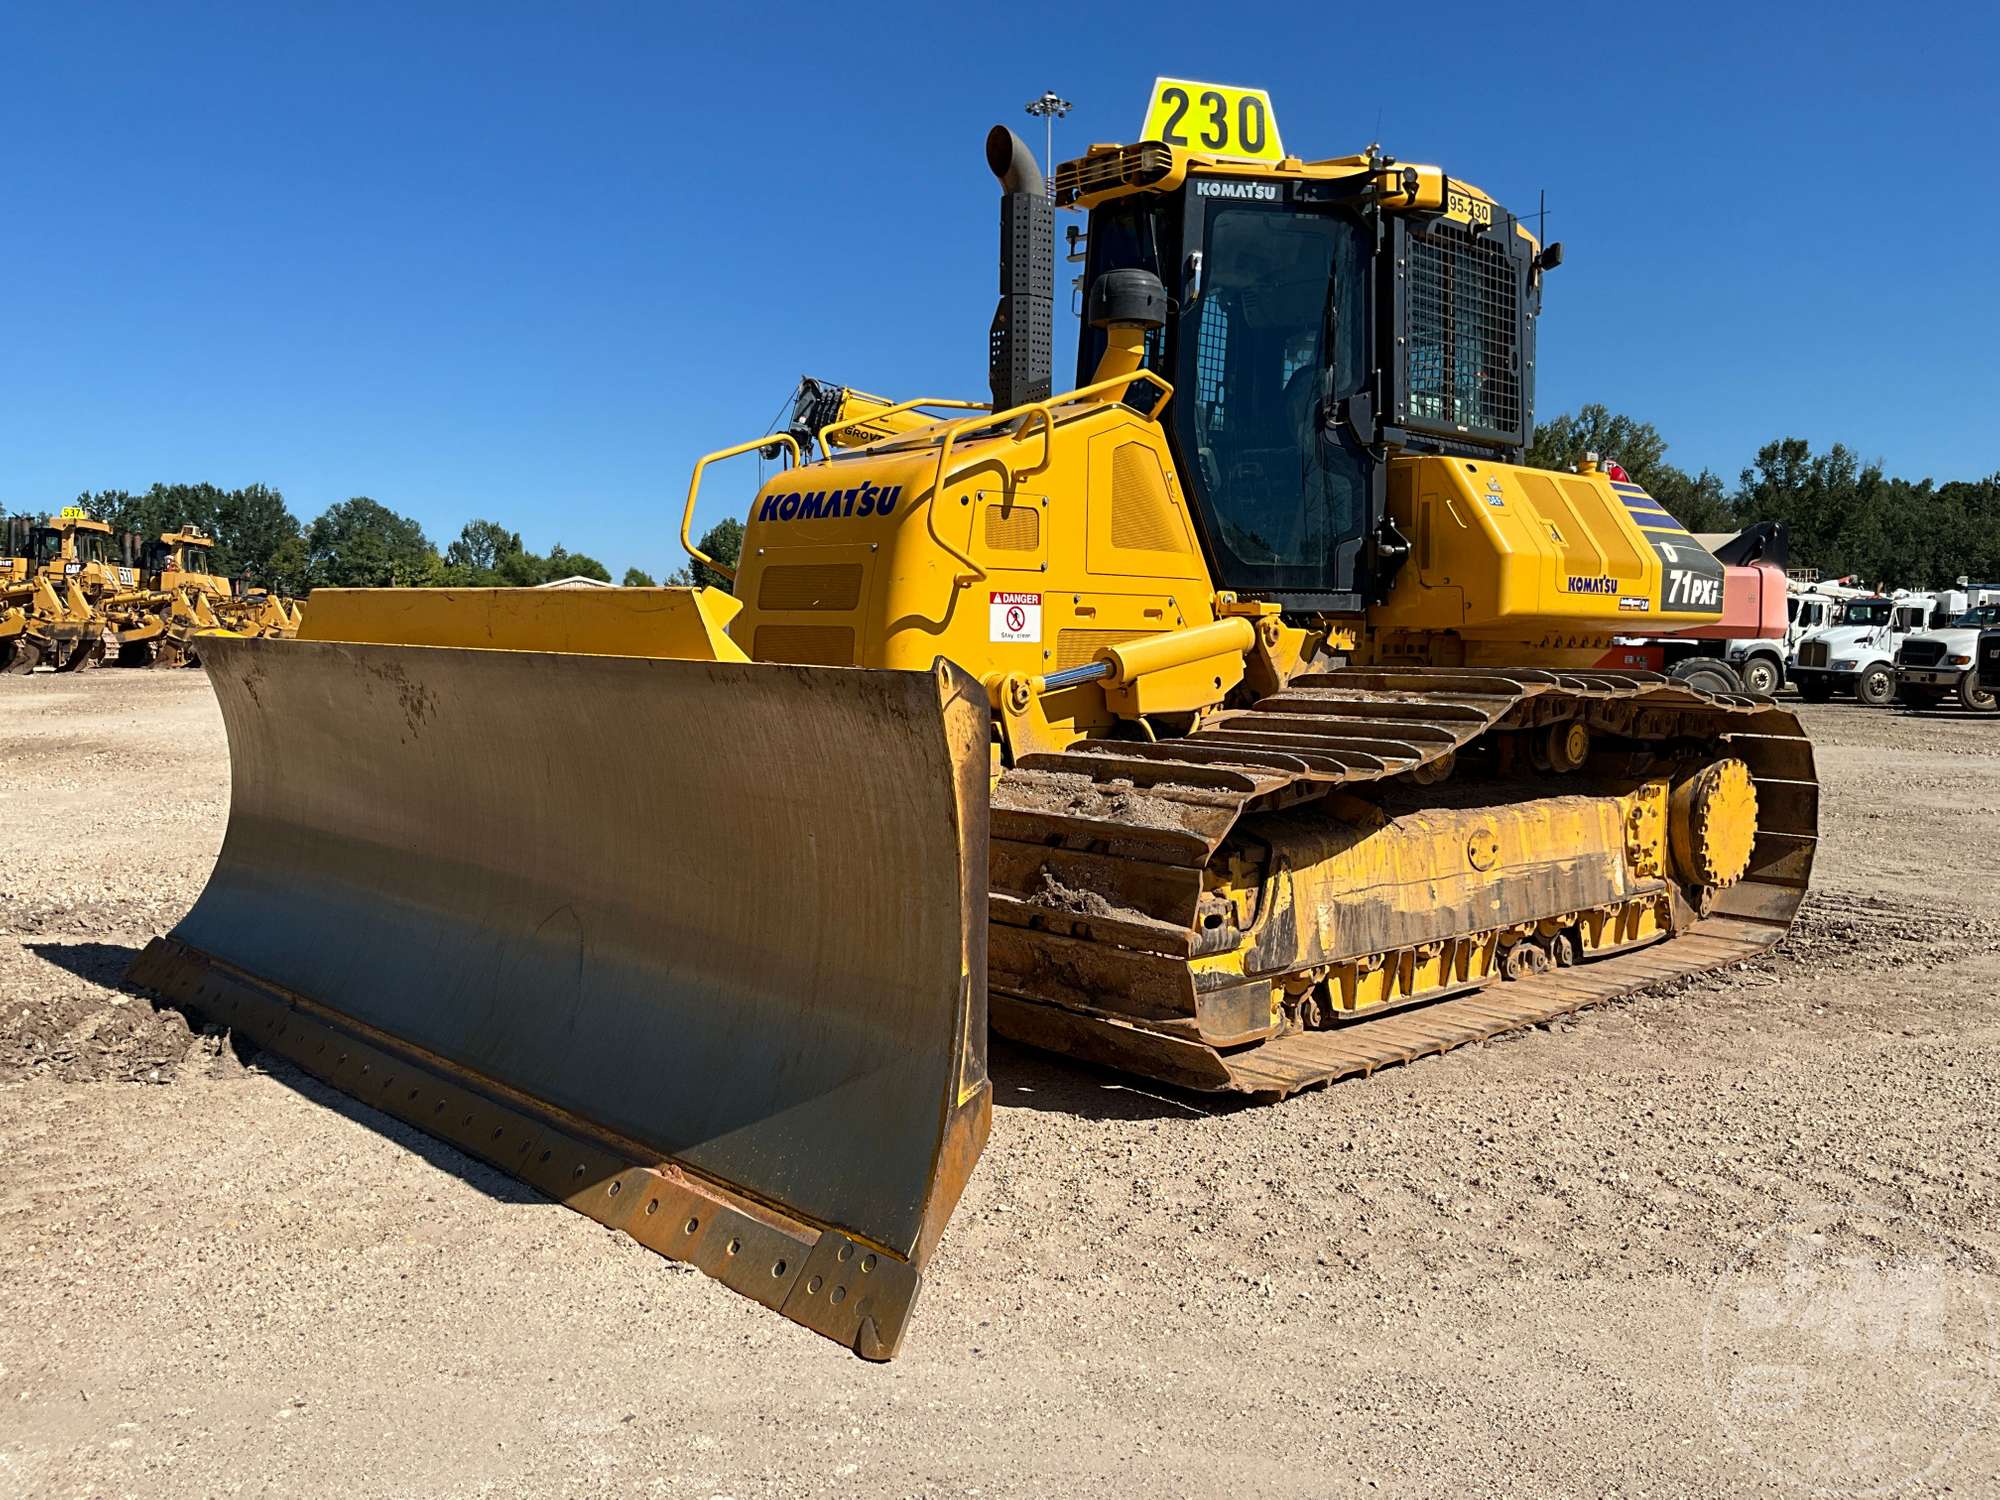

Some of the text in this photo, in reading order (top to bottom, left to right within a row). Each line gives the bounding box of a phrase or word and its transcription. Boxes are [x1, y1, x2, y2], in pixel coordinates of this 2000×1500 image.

[1161, 87, 1265, 153] 230
[1197, 182, 1276, 200] KOMATSU
[758, 480, 902, 522] KOMATSU
[63, 508, 81, 518] 537
[65, 564, 81, 574] CAT
[1568, 574, 1618, 593] KOMATSU
[1668, 570, 1719, 605] 71PXi
[1002, 593, 1039, 604] DANGER
